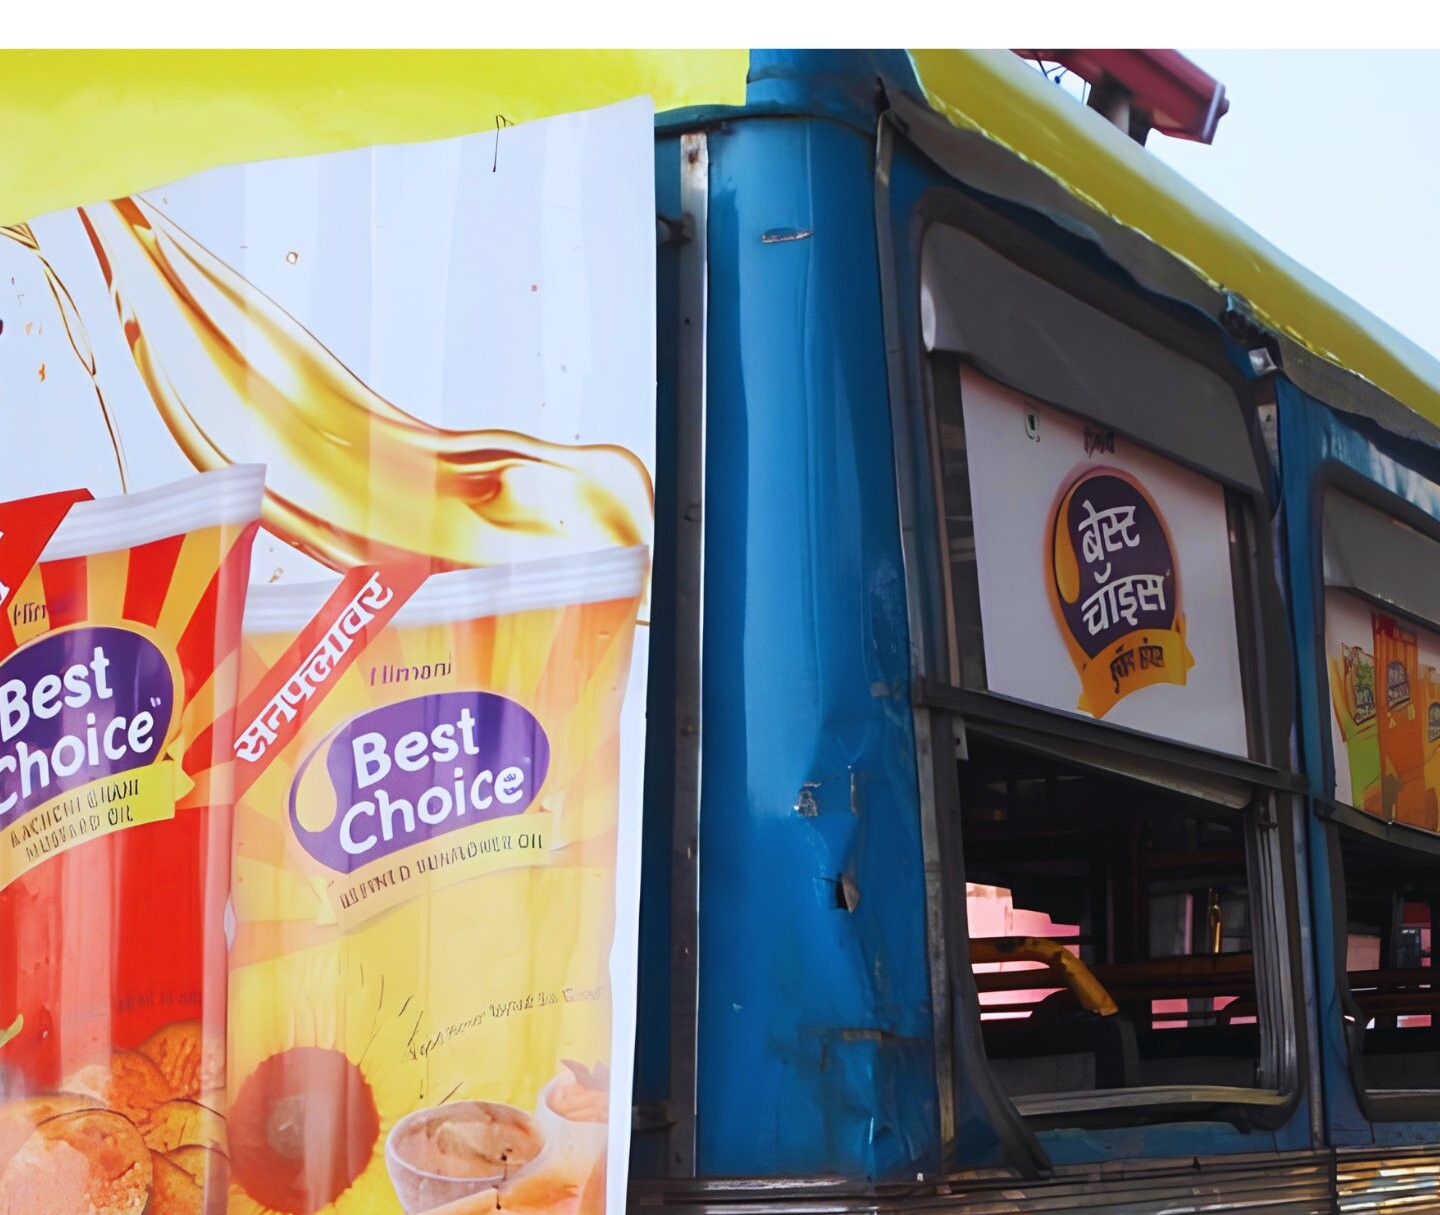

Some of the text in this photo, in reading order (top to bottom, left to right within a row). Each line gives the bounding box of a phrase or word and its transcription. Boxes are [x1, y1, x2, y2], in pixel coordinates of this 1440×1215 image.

[1078, 499, 1140, 564] बेस्ट
[1081, 562, 1169, 636] चॉइस
[350, 708, 479, 789] Best
[338, 765, 525, 855] Choice
